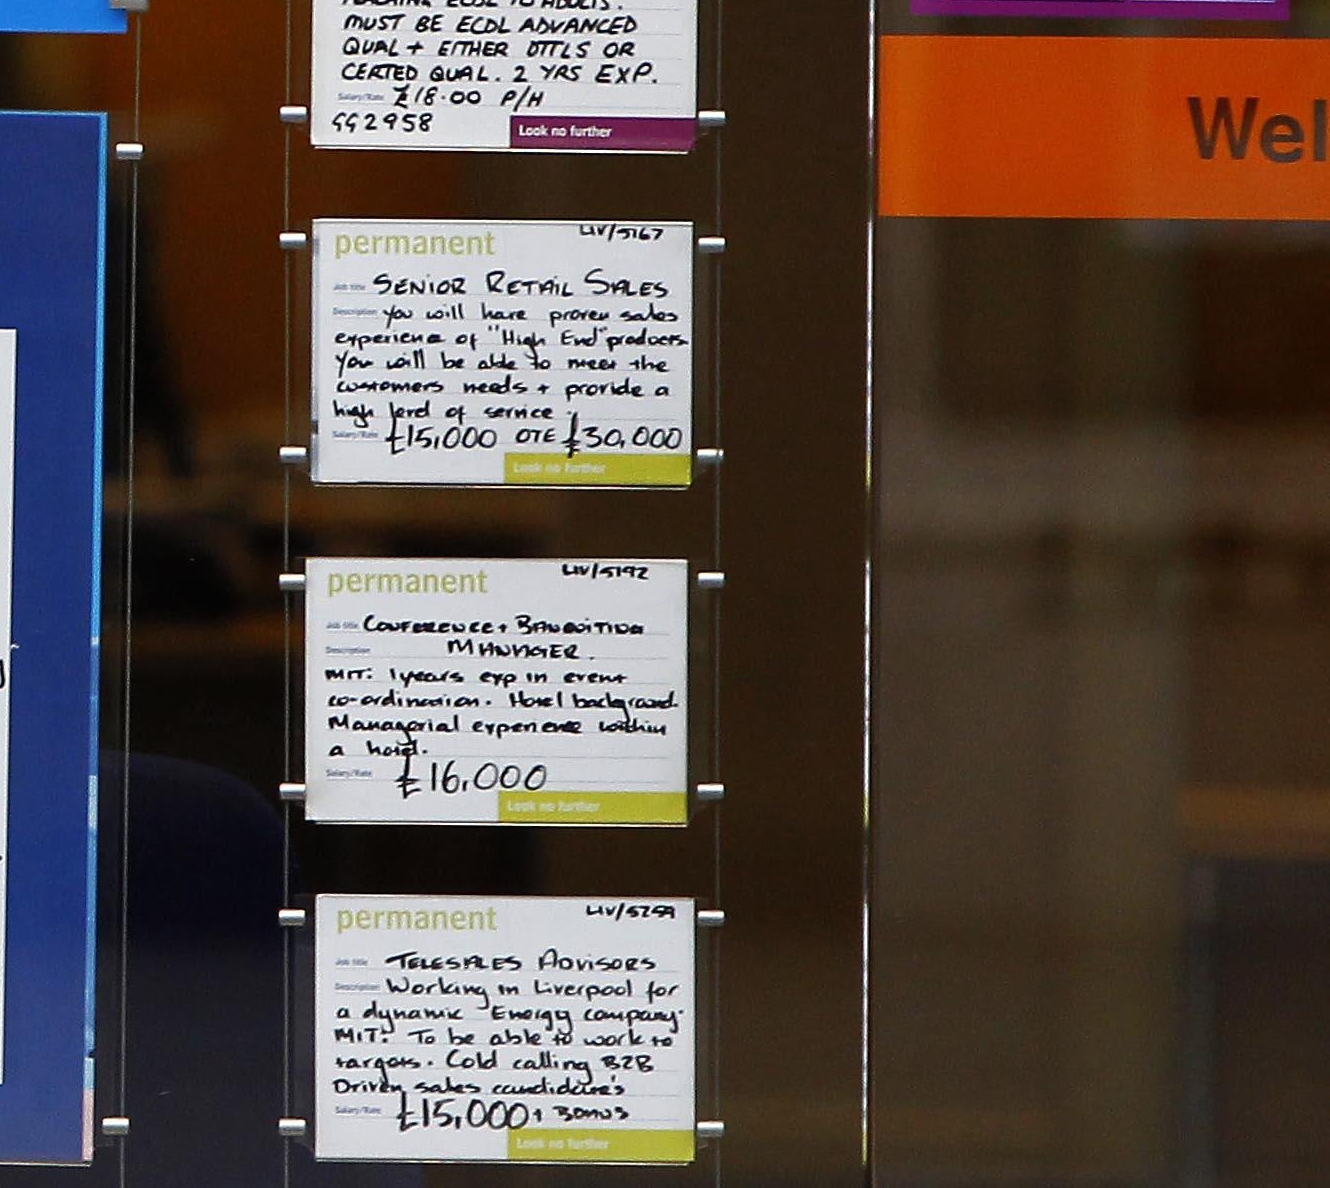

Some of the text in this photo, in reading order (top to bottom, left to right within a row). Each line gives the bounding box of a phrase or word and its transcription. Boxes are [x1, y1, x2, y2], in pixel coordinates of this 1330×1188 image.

[1188, 97, 1327, 164] Wel
[335, 232, 495, 259] permanent
[329, 571, 487, 597] permanent
[338, 907, 496, 934] permanent
[386, 977, 678, 1010] Working in Liverpool for
